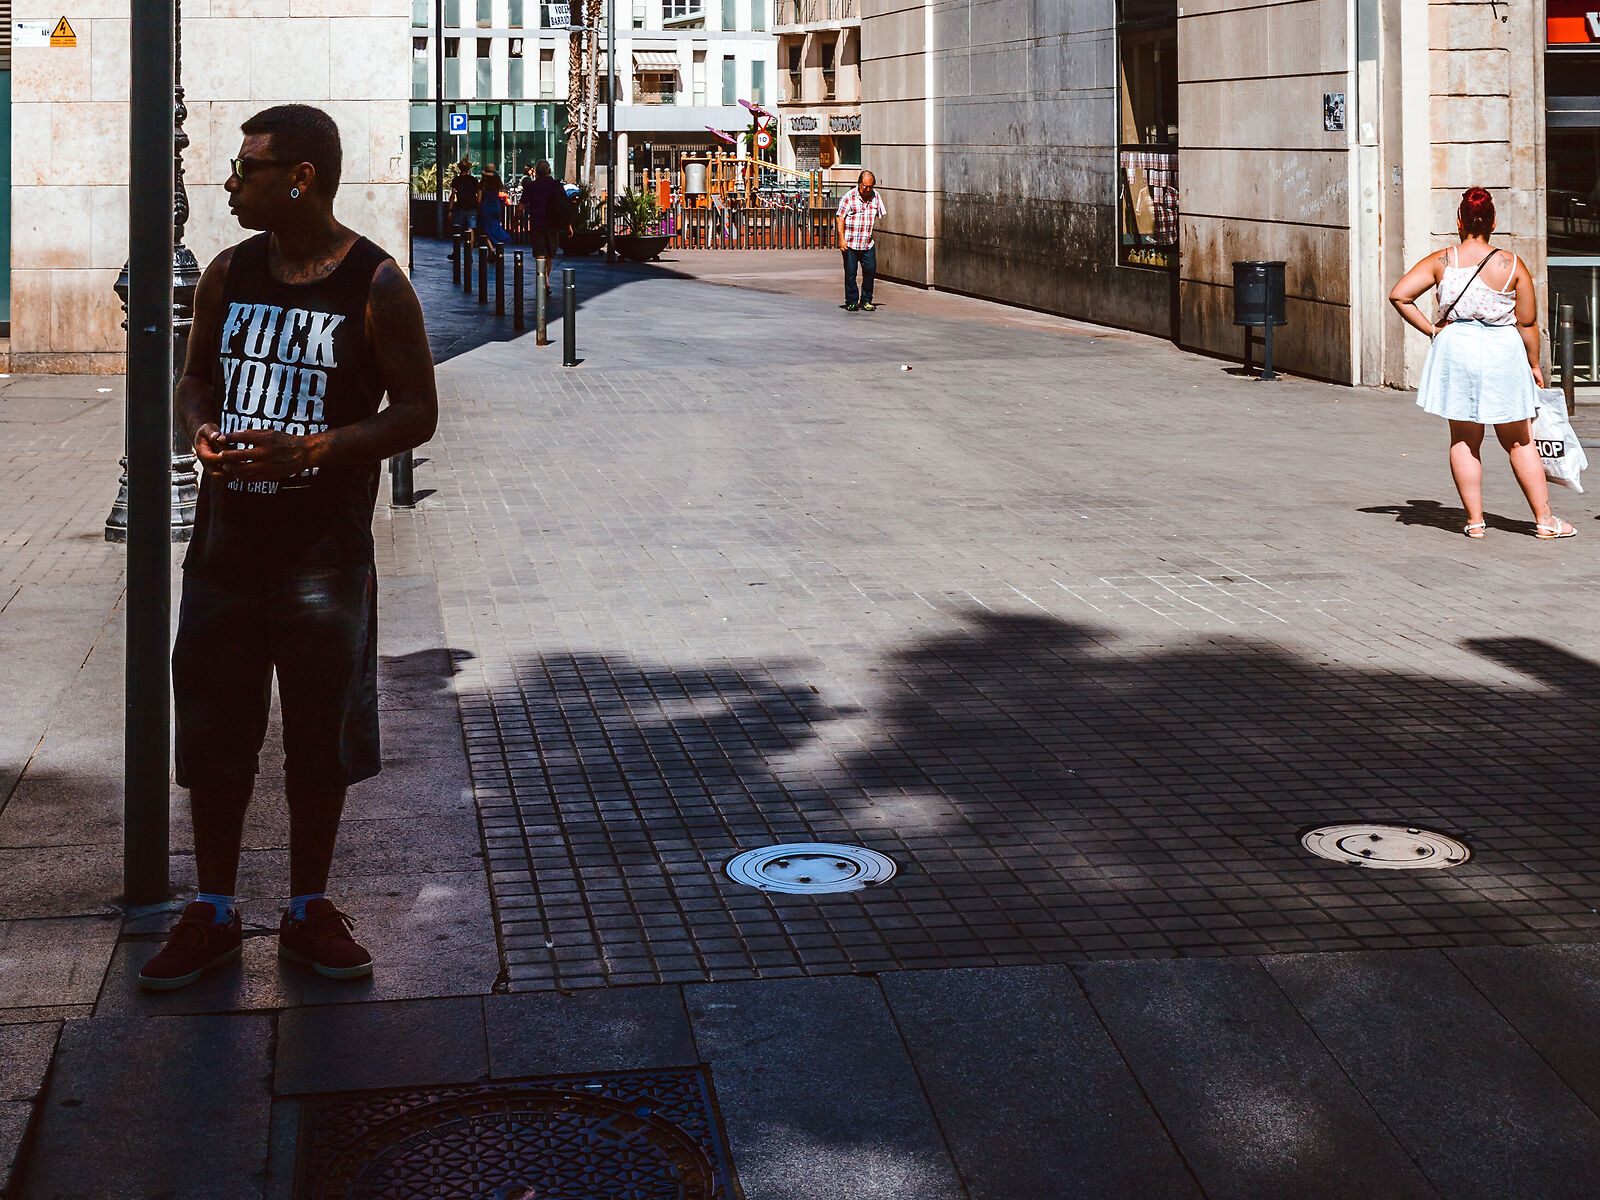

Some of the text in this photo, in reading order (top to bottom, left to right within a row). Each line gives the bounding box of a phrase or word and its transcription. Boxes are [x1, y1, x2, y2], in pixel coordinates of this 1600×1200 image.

[453, 115, 464, 129] P
[220, 302, 346, 368] FUCK
[219, 356, 328, 422] YOUR
